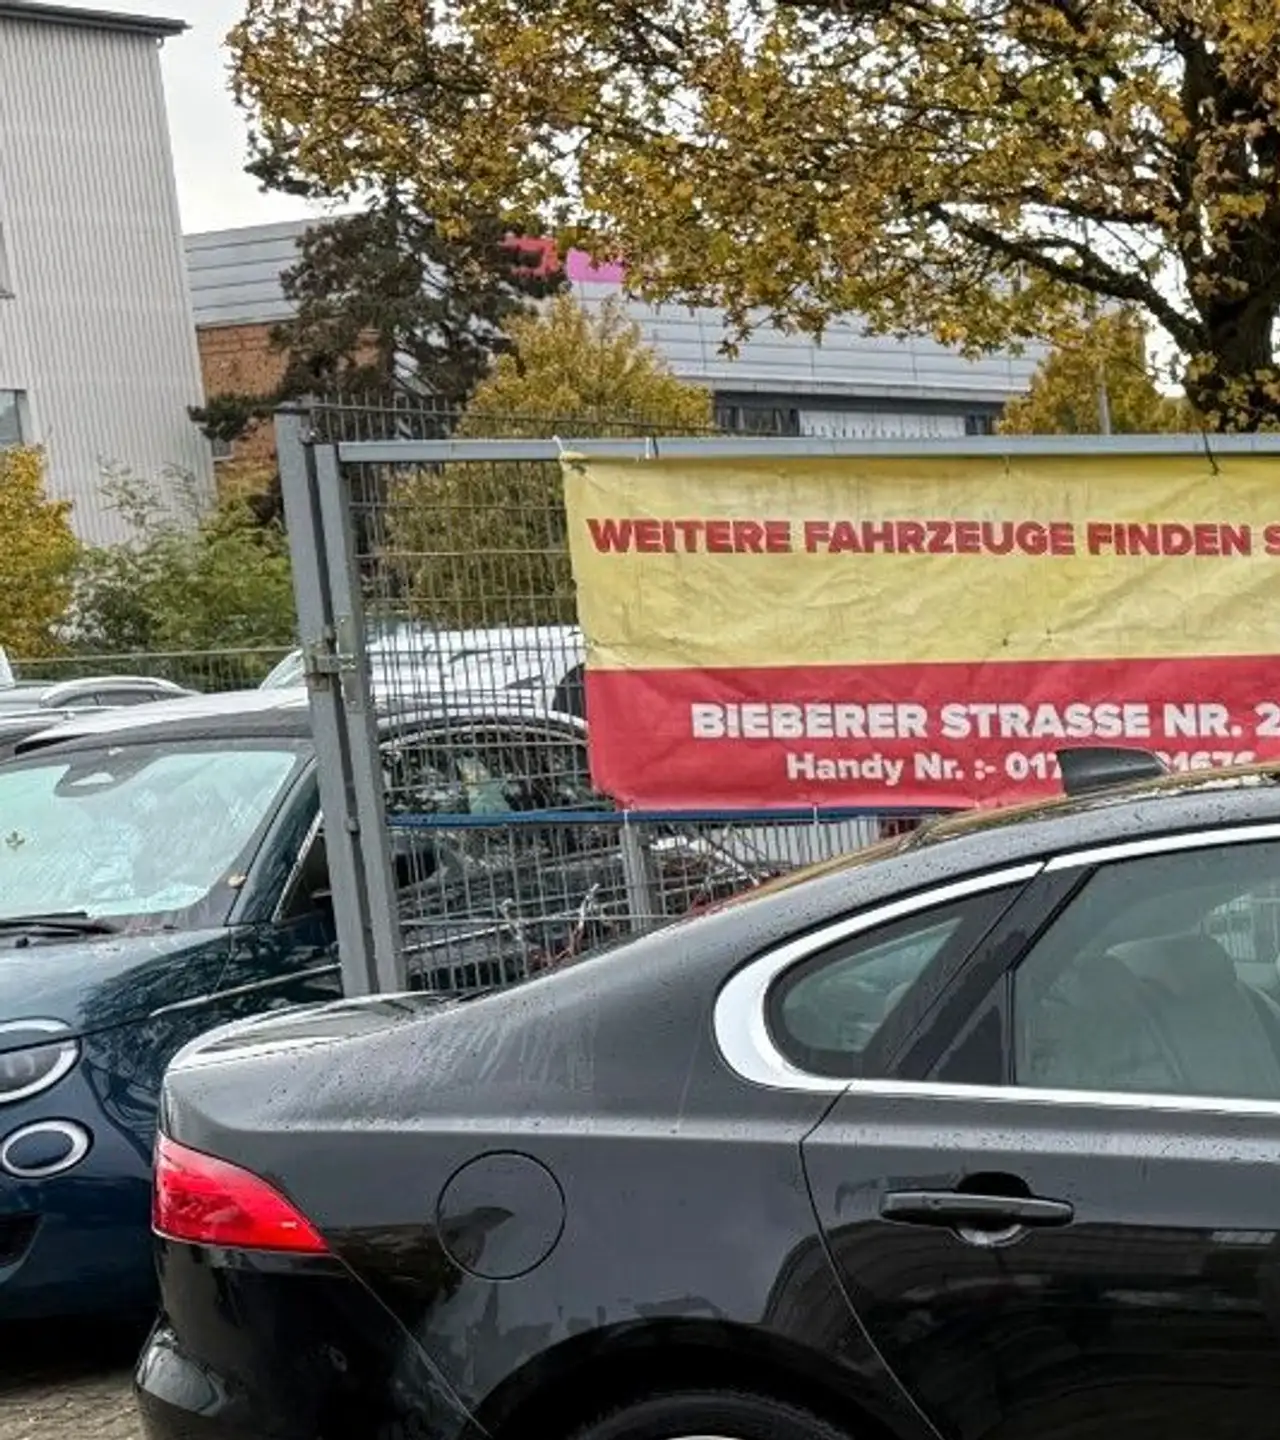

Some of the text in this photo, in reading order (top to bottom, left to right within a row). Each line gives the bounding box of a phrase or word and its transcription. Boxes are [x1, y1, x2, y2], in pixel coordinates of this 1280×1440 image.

[587, 517, 793, 555] WEITERE
[803, 520, 1076, 556] FAHRZEUGE
[1087, 523, 1252, 557] FINDEN
[691, 702, 928, 739] BIEBERER
[940, 702, 1151, 738] STRASSE
[1164, 703, 1241, 738] NR.
[786, 752, 904, 786] Handy
[914, 754, 963, 781] Nr.
